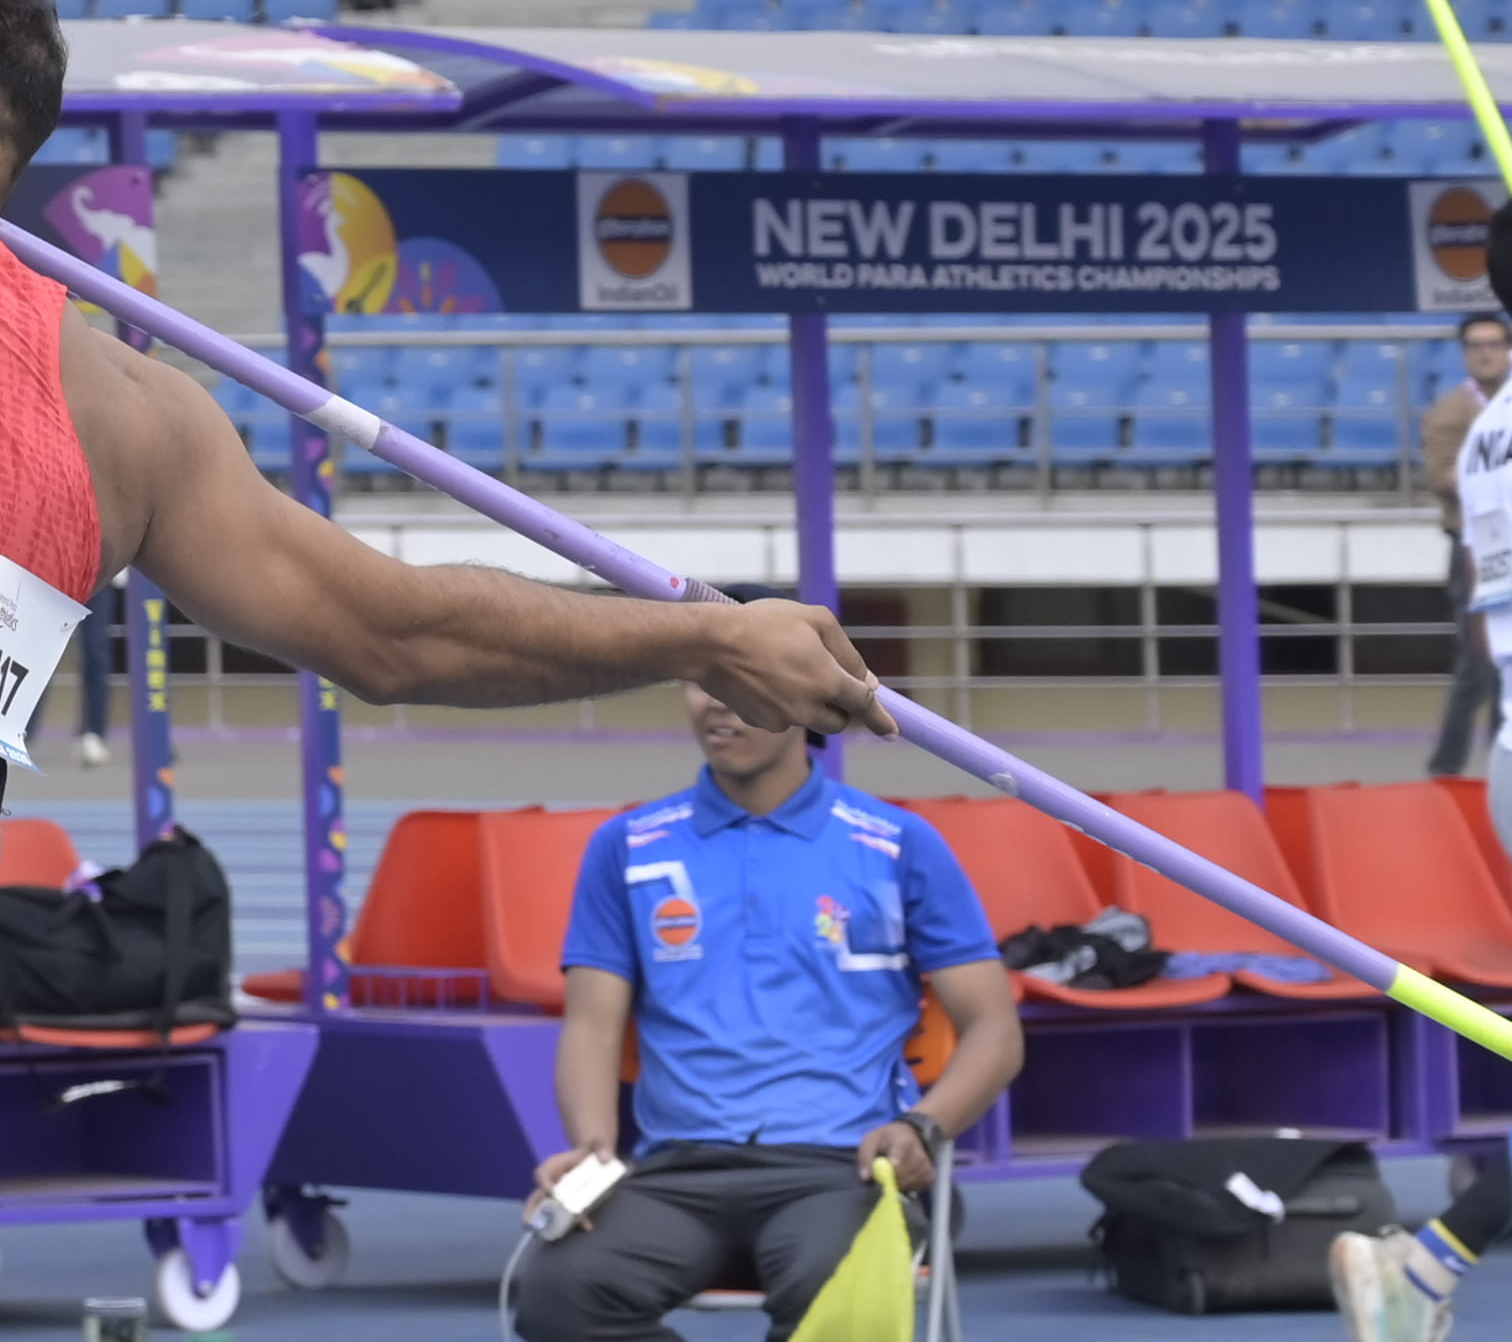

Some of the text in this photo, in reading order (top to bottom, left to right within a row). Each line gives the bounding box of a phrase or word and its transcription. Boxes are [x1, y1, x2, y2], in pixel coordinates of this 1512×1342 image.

[753, 198, 1278, 261] NEW DELHI 2025
[755, 262, 1281, 292] WORLD PARA ATHLETICS CHAMPIONSHIPS
